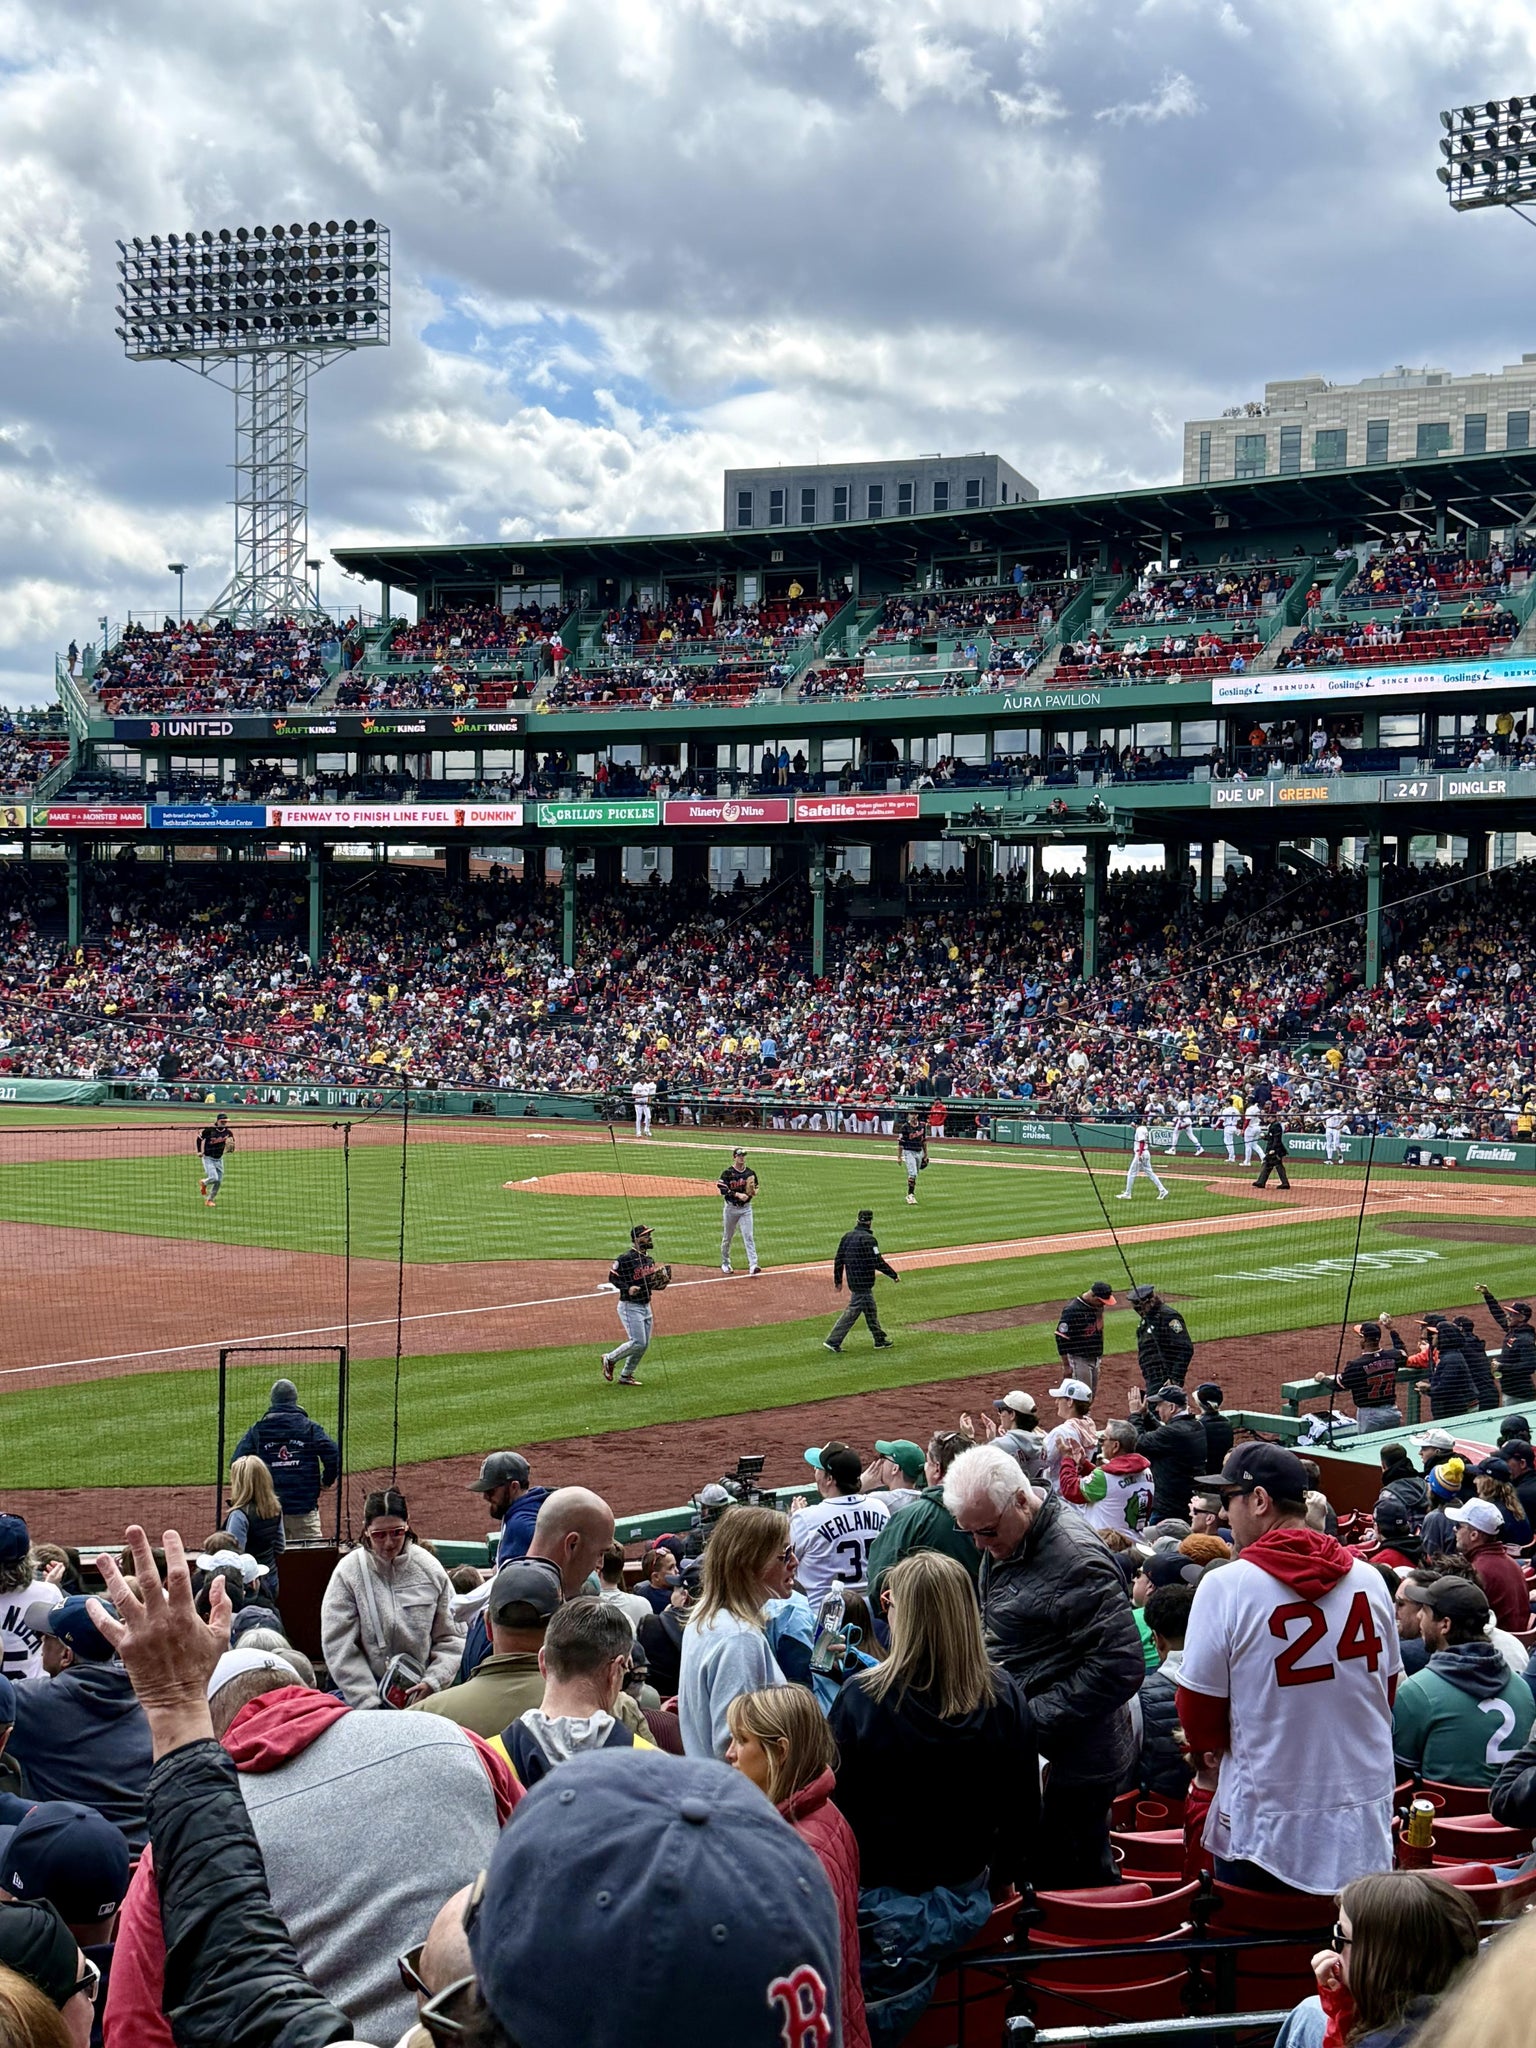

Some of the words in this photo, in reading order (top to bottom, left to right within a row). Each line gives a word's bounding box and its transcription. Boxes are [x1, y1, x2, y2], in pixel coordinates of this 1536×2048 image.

[1382, 677, 1409, 685] SINCE
[1443, 673, 1481, 683] Goslings
[1219, 687, 1253, 697] Goslings
[1273, 683, 1316, 691] BERMUDA
[1328, 680, 1364, 691] Goslings
[1046, 693, 1101, 707] PAVILION
[168, 722, 234, 736] UNITED
[275, 726, 337, 736] DRAFTKINGS
[363, 725, 426, 735] DRAFTKINGS
[454, 723, 517, 734] DRAFTKINGS
[1278, 787, 1328, 800] GREENE
[1393, 783, 1428, 798] .247
[1449, 781, 1506, 795] DINGLER
[1217, 789, 1242, 802] DUE
[1247, 788, 1264, 801] UP
[287, 812, 332, 822] FENWAY
[335, 812, 350, 822] TO
[353, 812, 390, 822] FINISH
[393, 812, 418, 822] LINE
[422, 811, 449, 821] FUEL
[470, 811, 517, 821] DUNKIN'
[557, 808, 603, 820] GRILLO'S
[608, 807, 655, 819] PICKLES
[689, 806, 722, 819] Ninety
[741, 806, 765, 817] Nine
[798, 803, 856, 817] Safelite
[83, 813, 118, 821] MONSTER
[261, 1089, 281, 1103] JIM
[1367, 1371, 1396, 1399] 77
[1268, 1591, 1383, 1687] 24
[1477, 1697, 1525, 1765] 2
